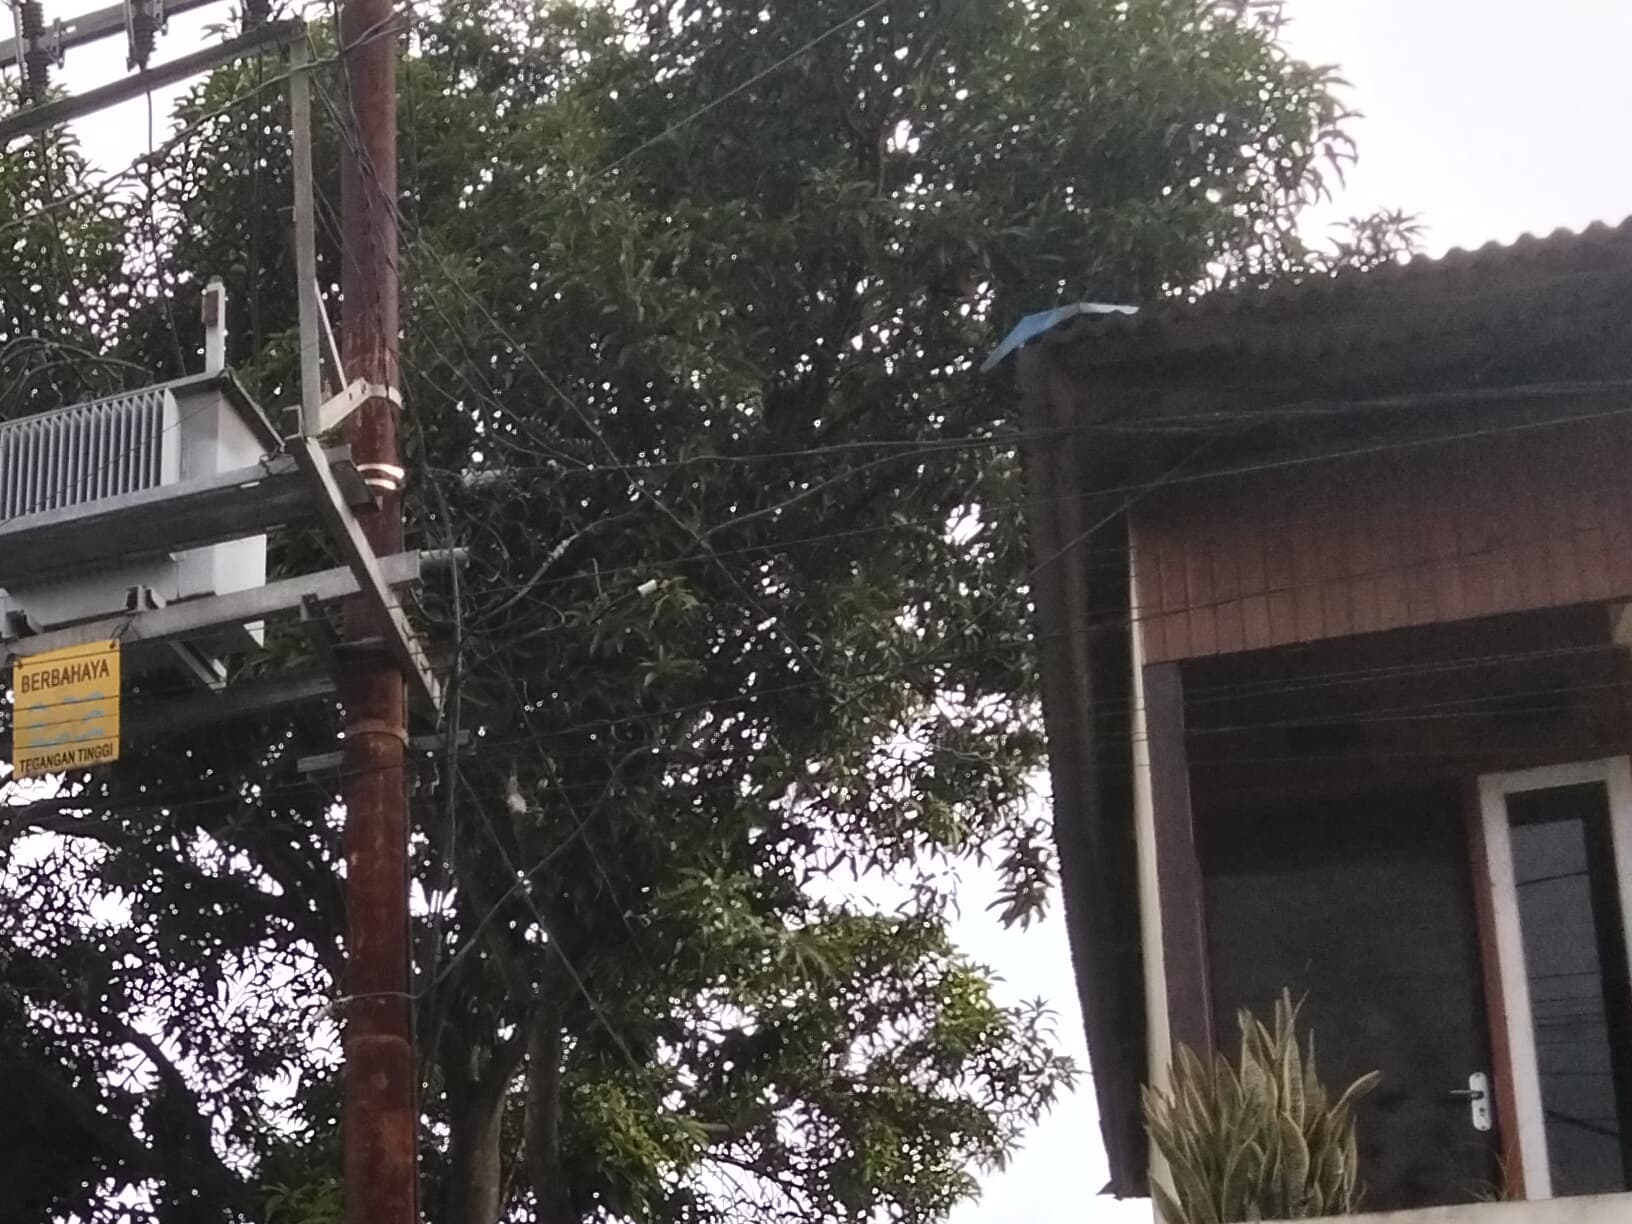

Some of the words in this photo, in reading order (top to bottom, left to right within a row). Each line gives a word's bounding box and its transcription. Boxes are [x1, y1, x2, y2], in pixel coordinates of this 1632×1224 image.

[21, 658, 110, 694] BERBAHAYA
[20, 748, 76, 773] TEGANGAN
[77, 743, 114, 763] TINGGI
